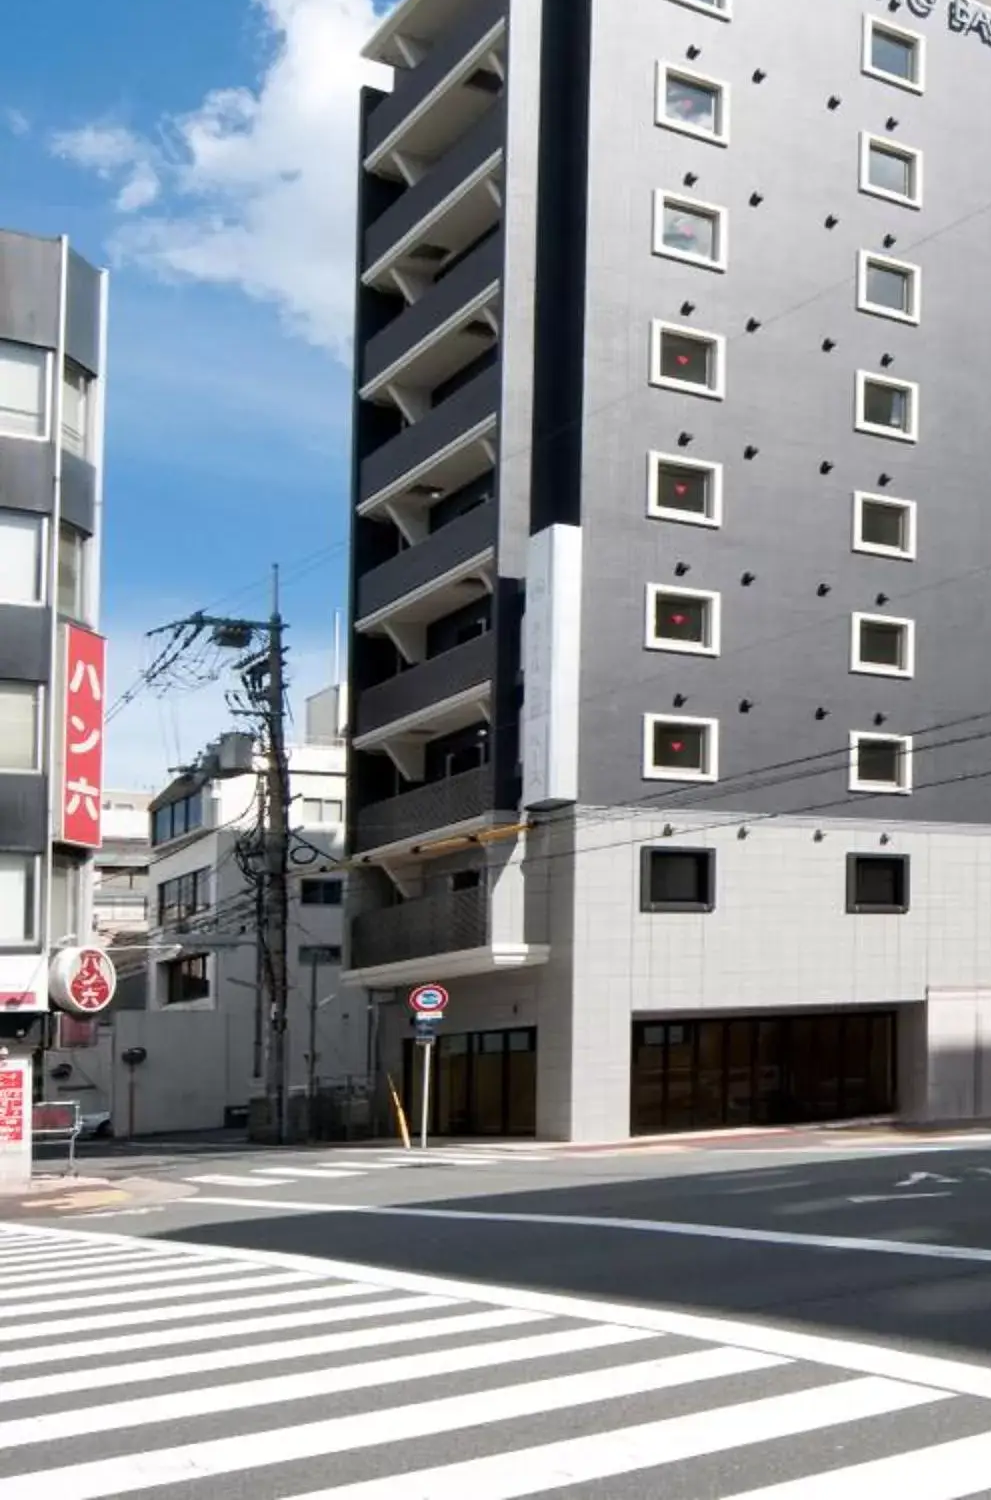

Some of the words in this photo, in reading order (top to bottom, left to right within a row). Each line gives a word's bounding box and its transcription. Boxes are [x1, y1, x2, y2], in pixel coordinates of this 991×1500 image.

[66, 659, 101, 821] ハン六
[80, 955, 100, 1005] ハン六
